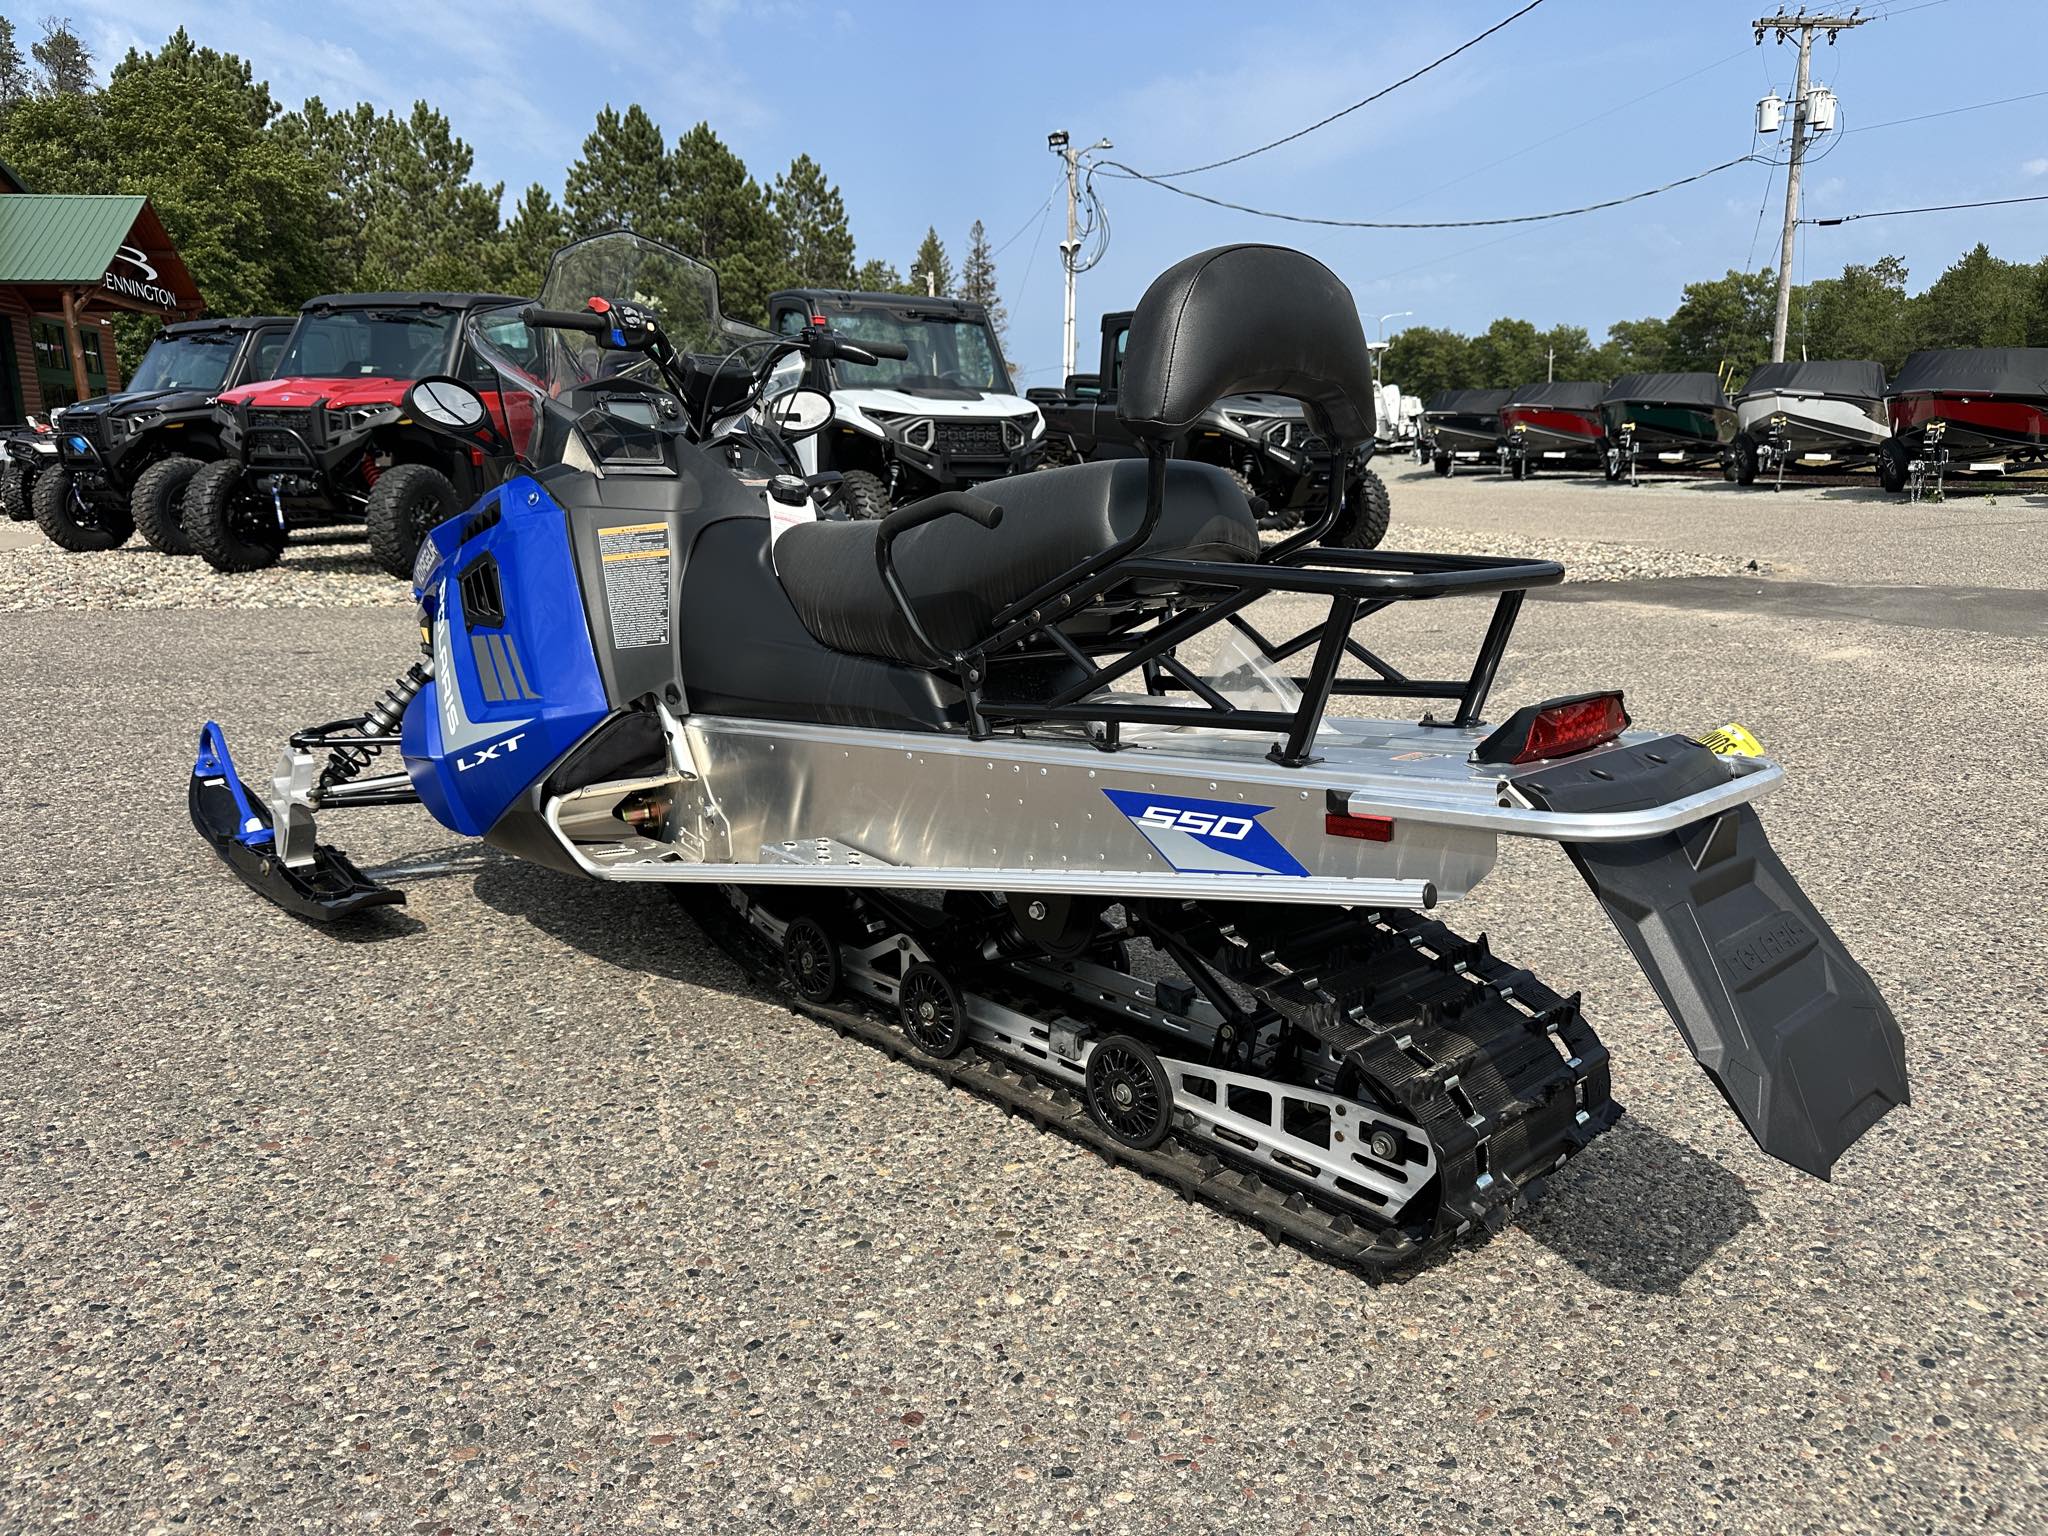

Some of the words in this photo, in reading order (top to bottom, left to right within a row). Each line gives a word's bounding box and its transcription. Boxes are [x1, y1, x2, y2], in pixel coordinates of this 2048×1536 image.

[102, 271, 177, 307] ENNINGTON
[937, 429, 999, 442] POLARIS
[437, 575, 460, 736] POLARIS
[456, 733, 526, 772] LXT
[1138, 806, 1253, 841] 550
